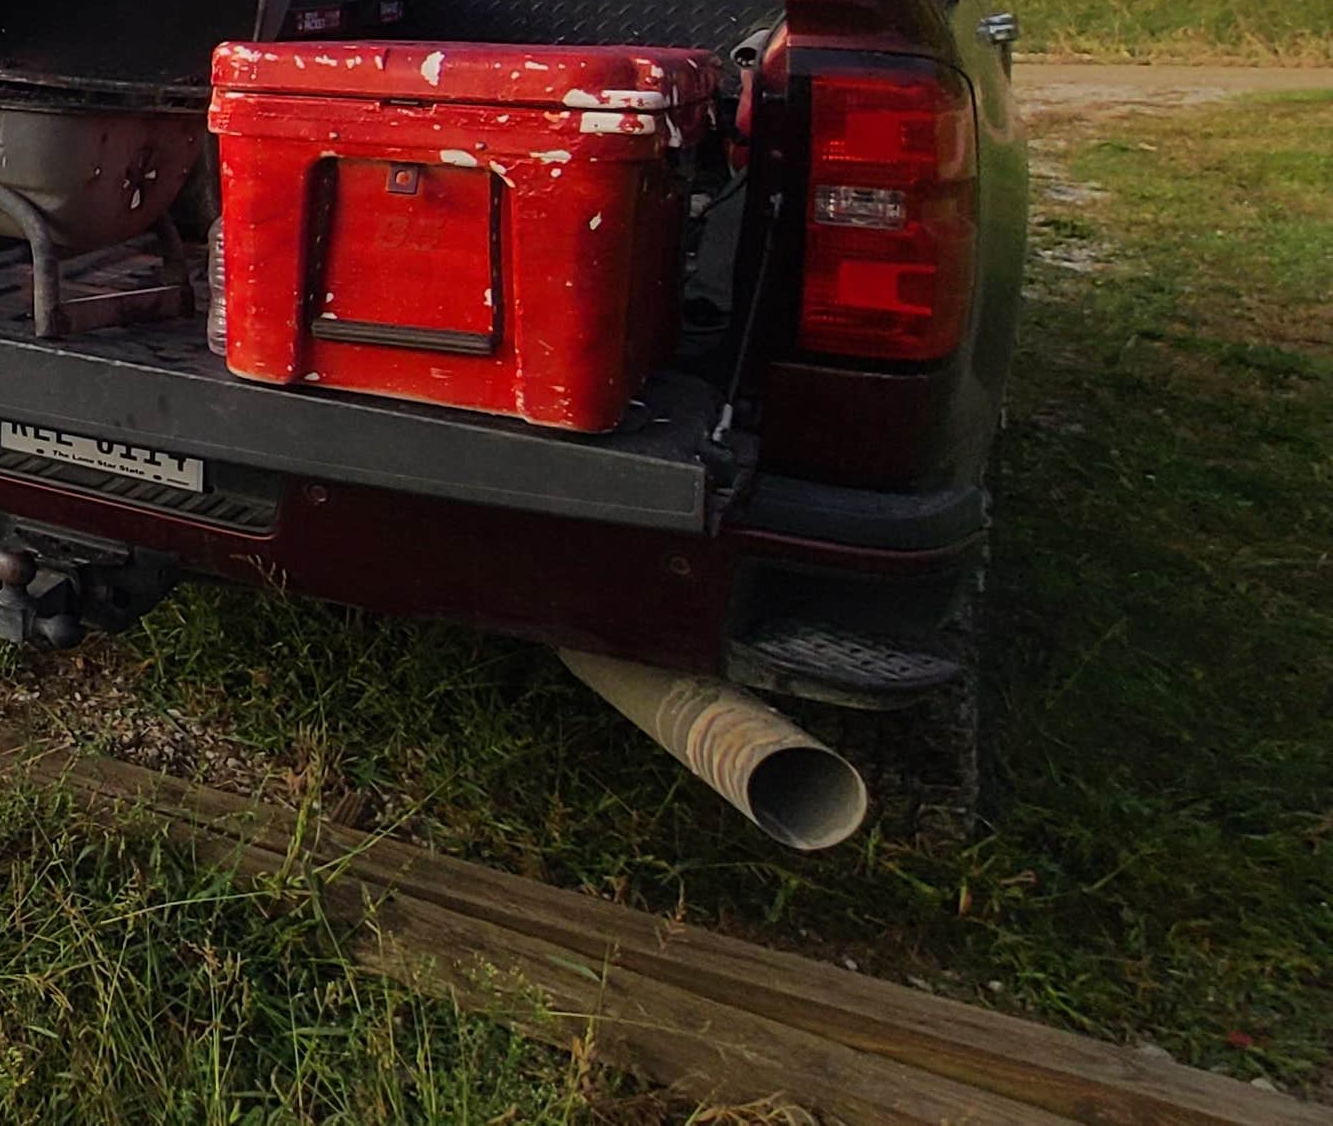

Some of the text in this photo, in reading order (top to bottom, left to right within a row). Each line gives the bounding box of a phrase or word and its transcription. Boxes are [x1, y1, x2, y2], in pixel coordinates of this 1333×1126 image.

[53, 450, 145, 474] The Lone Star State
